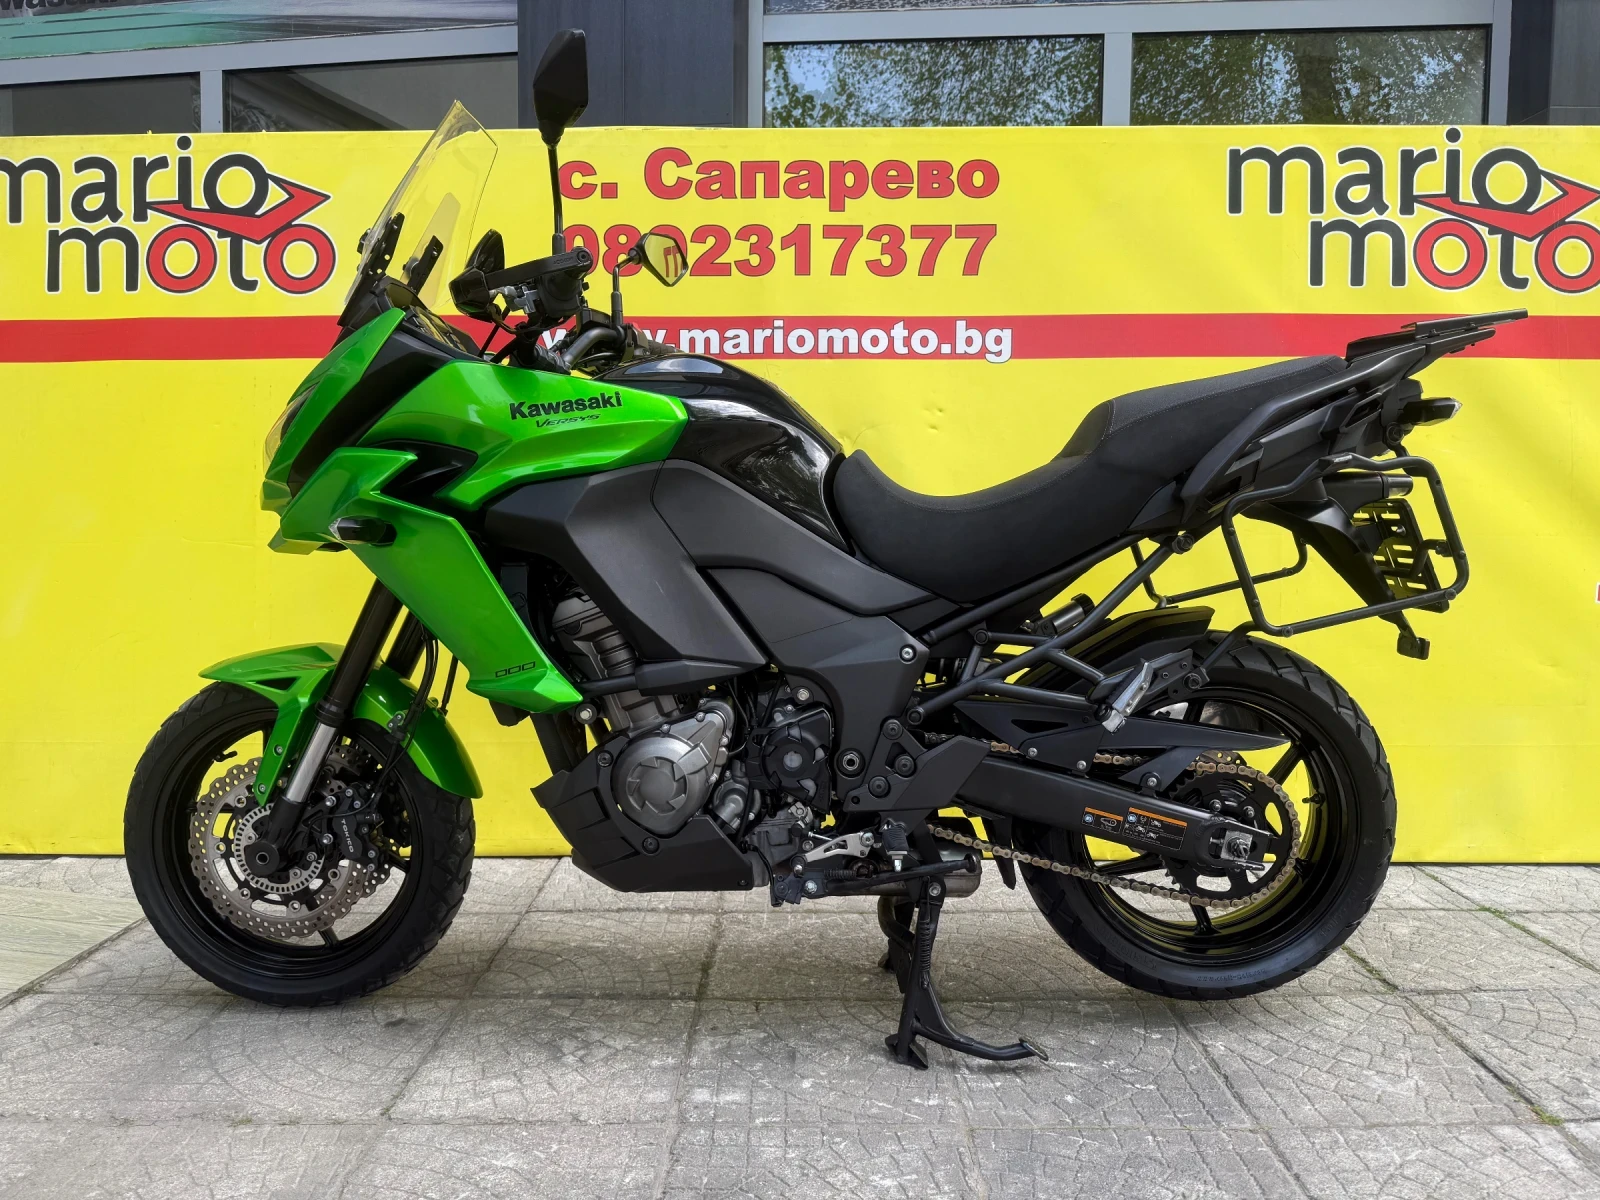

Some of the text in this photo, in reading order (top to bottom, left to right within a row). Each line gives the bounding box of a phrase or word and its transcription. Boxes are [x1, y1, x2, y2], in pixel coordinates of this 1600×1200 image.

[0, 136, 270, 224] mario
[643, 146, 1000, 213] Сапарево
[1228, 127, 1541, 217] mario
[47, 221, 336, 295] moto
[1309, 216, 1600, 293] moto
[541, 319, 1013, 363] .mariomoto.bg
[509, 391, 623, 420] Kawasaki
[341, 818, 354, 853] TOKICO
